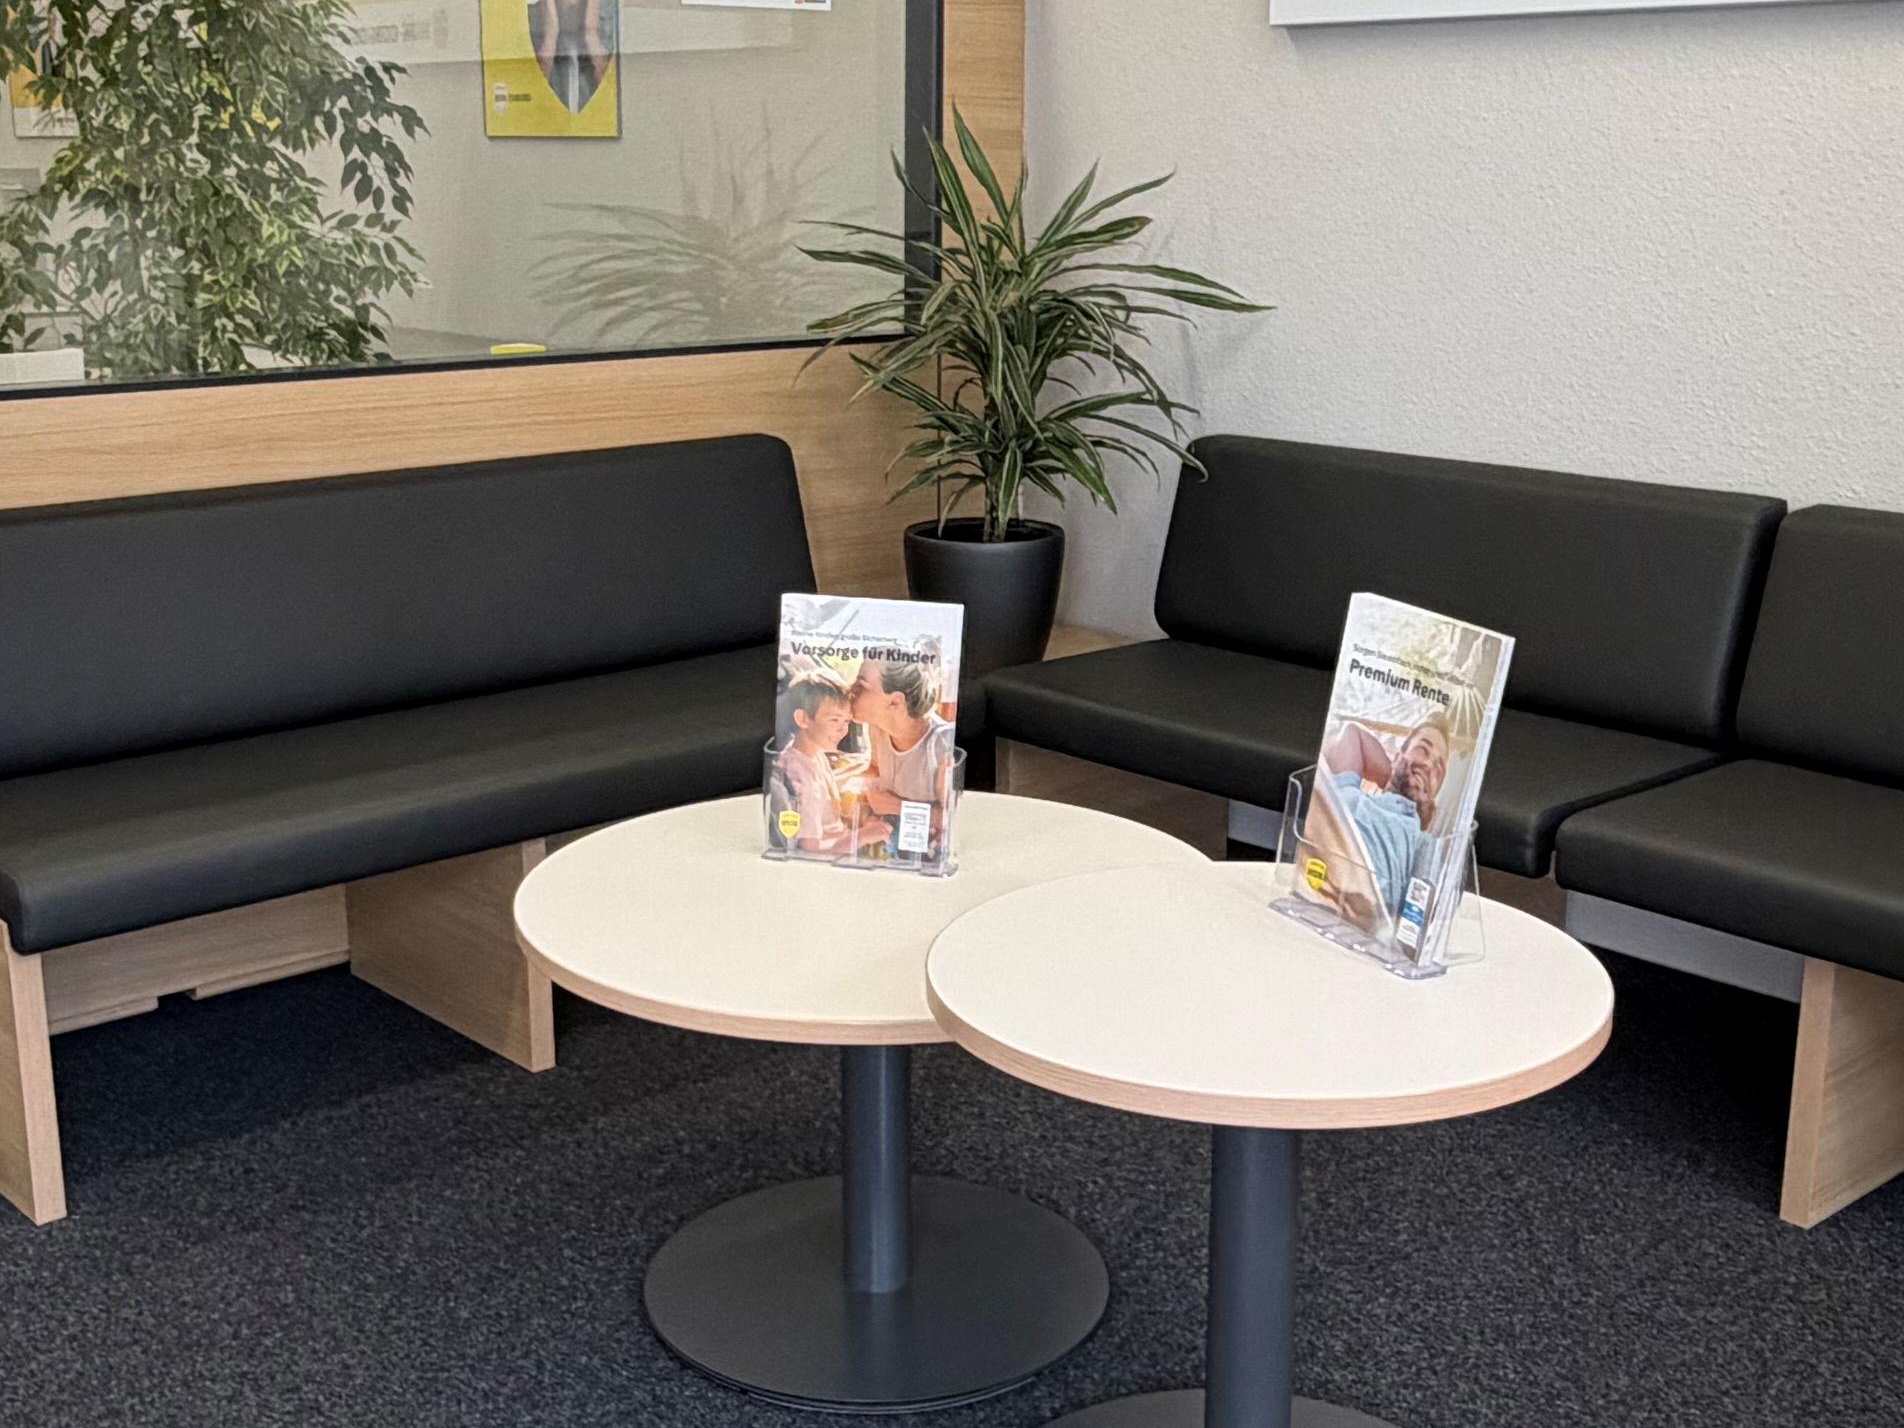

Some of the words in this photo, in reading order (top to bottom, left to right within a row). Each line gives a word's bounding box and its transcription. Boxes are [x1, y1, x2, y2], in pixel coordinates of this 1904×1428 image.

[791, 641, 859, 662] Vorsorge
[862, 646, 883, 660] für
[885, 648, 937, 665] Kinder
[1349, 657, 1410, 692] Premium
[1411, 678, 1450, 706] Rente
